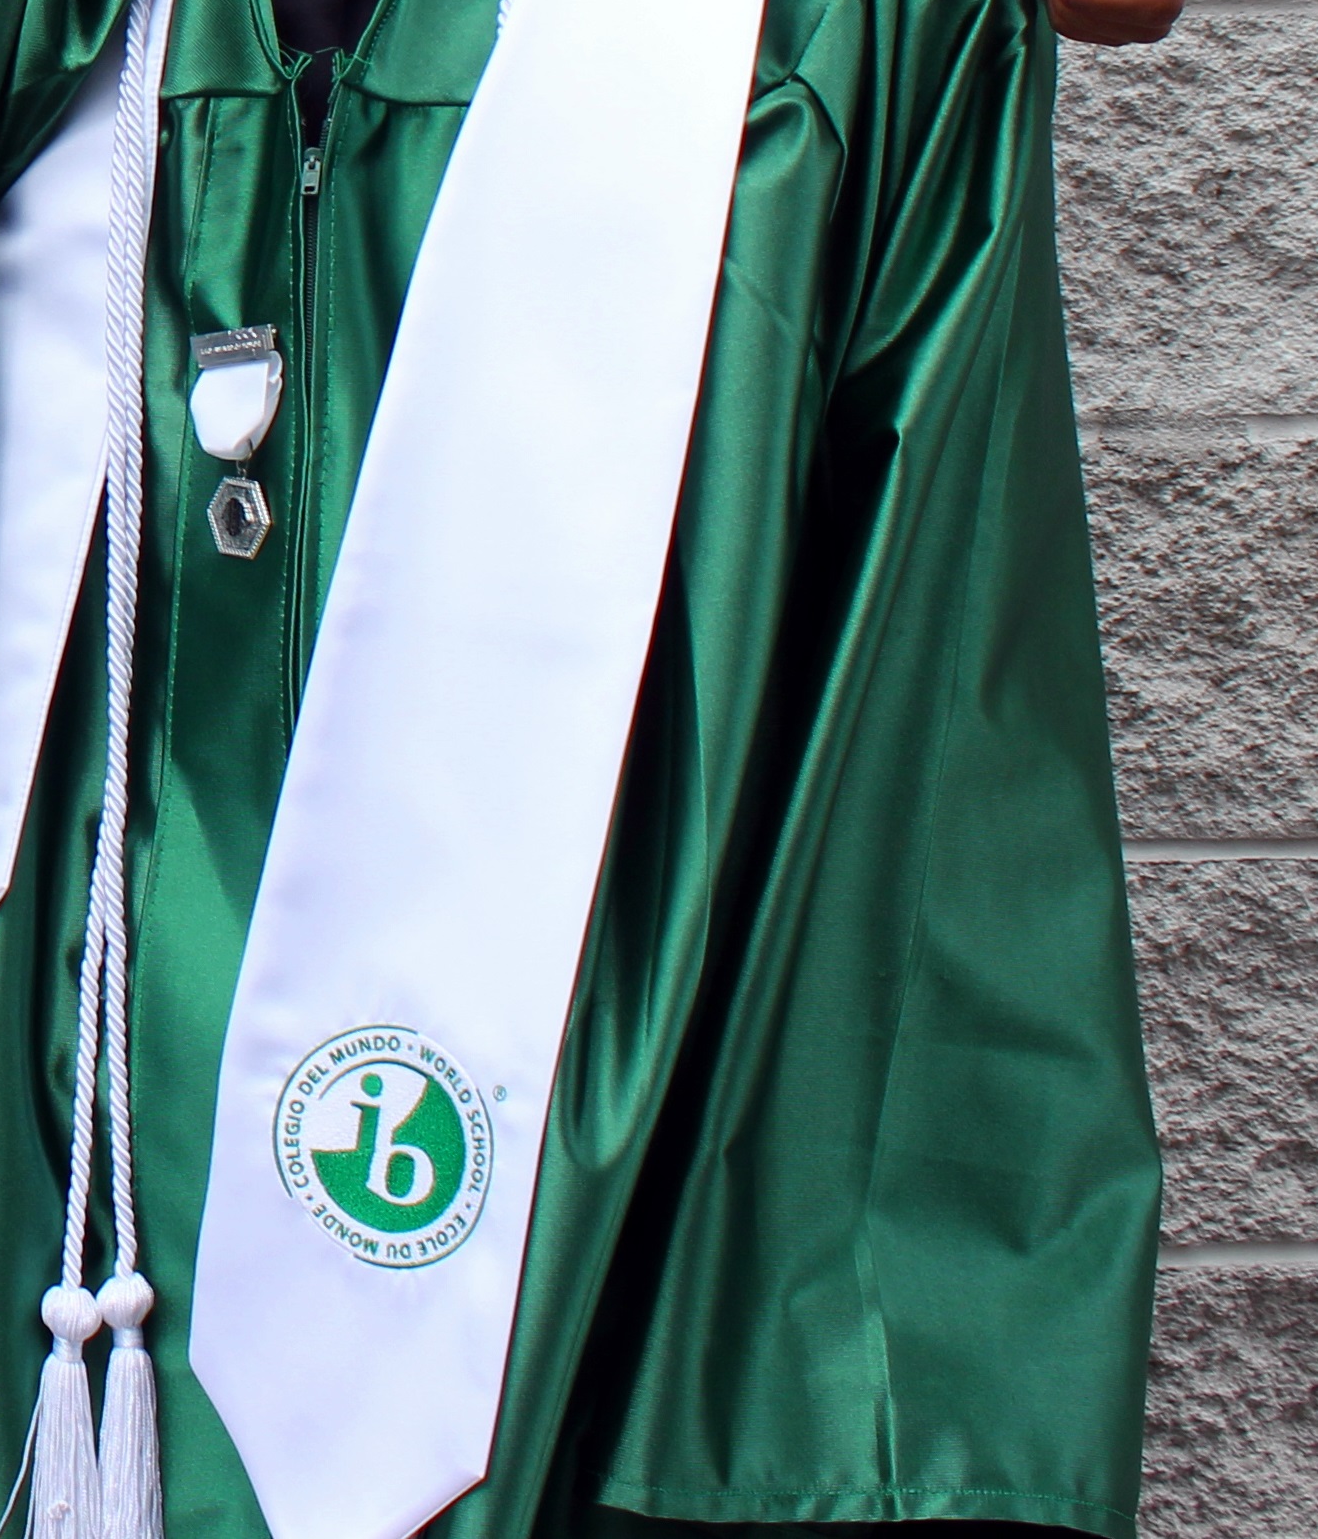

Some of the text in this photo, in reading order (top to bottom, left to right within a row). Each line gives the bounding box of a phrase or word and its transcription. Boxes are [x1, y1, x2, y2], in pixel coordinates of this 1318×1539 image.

[284, 1035, 401, 1189] COLEGIO DEL MUNDO
[419, 1045, 486, 1192] WORLD SCHOOL
[311, 1203, 467, 1259] ECOLE DU MONDE
